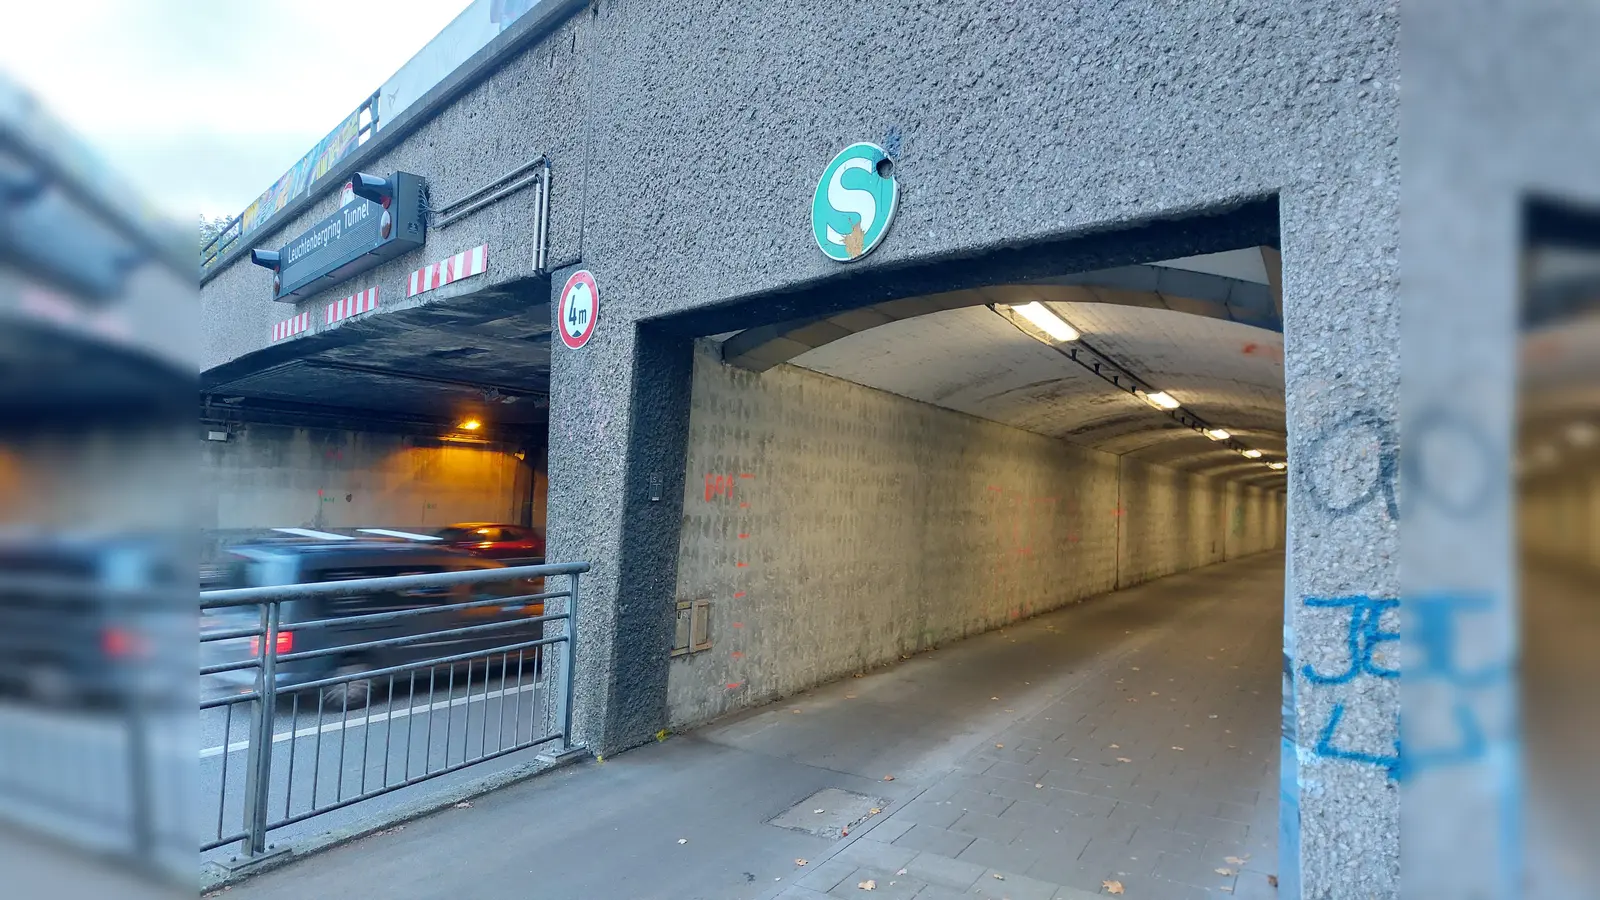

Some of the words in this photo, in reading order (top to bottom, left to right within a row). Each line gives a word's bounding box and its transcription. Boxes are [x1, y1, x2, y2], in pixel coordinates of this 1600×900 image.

[288, 219, 341, 264] Leuchtenbergring
[343, 198, 370, 230] Tunnel
[826, 157, 876, 246] S
